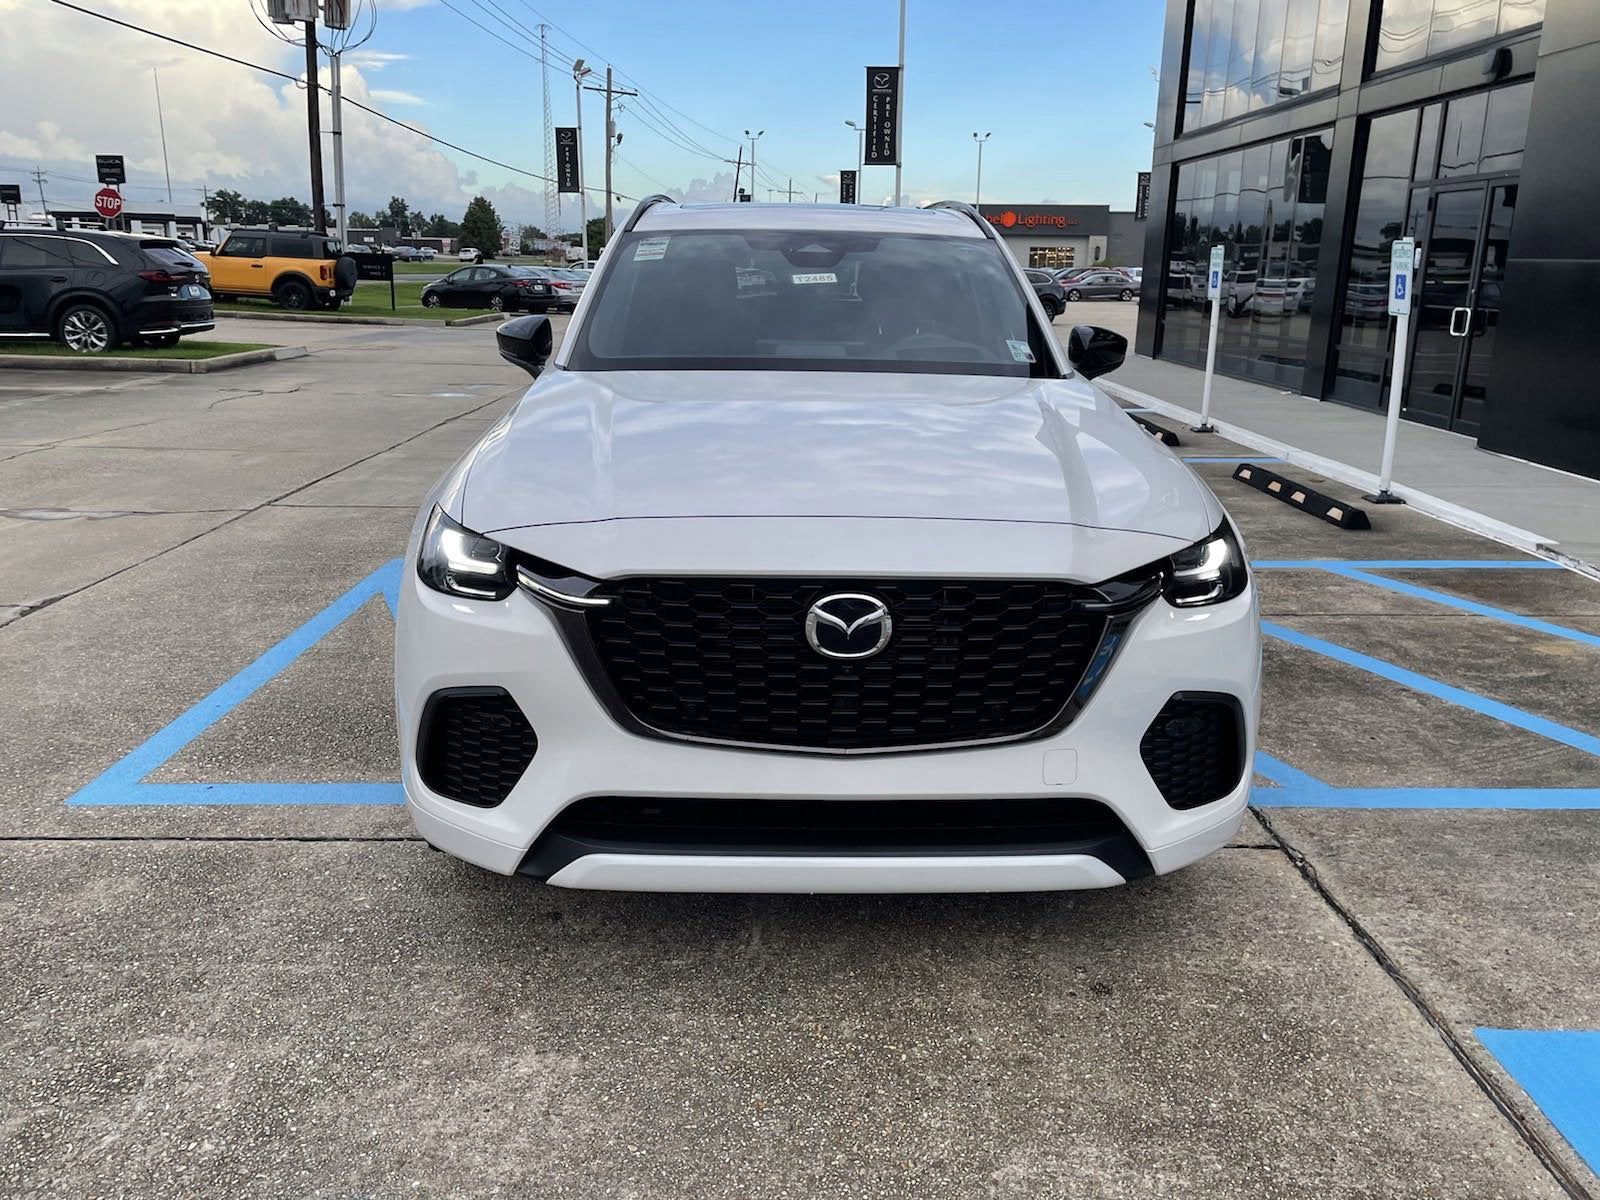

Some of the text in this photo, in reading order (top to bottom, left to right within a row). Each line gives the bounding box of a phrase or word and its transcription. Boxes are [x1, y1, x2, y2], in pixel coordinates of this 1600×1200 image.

[871, 95, 879, 158] CERTIFIED
[883, 121, 892, 156] OWNED
[95, 195, 121, 210] STOP
[1017, 213, 1067, 228] Lighting
